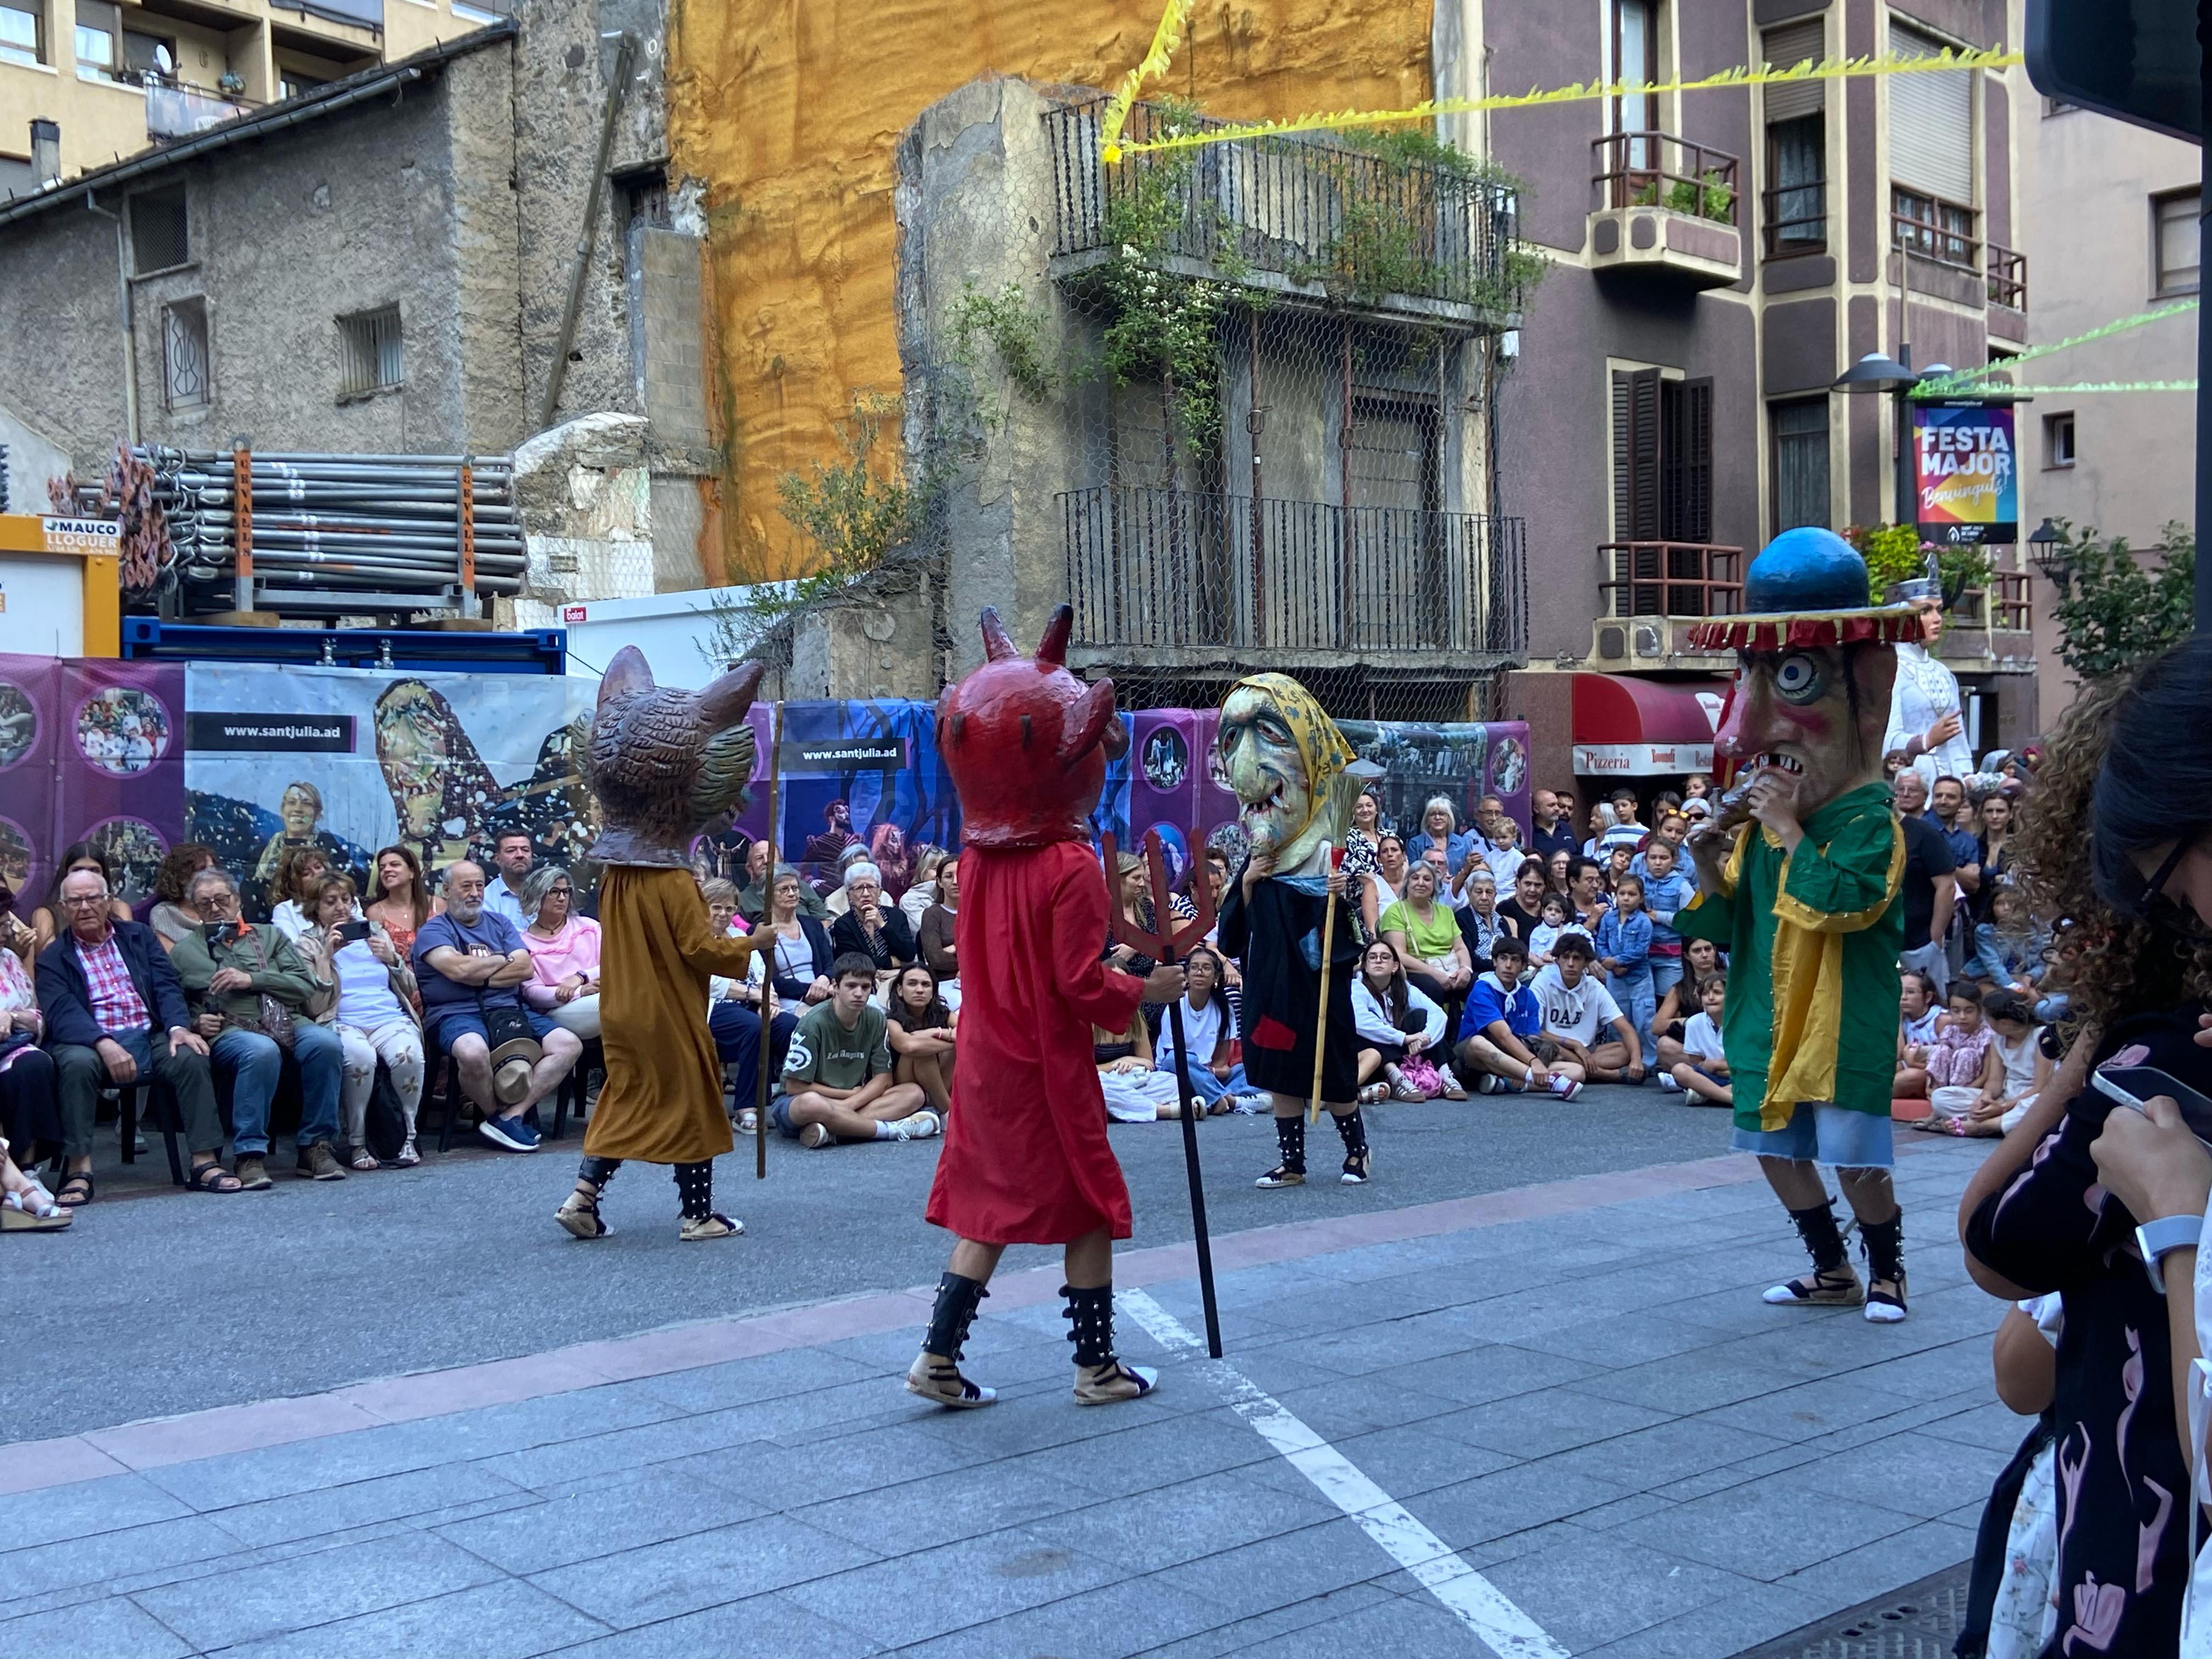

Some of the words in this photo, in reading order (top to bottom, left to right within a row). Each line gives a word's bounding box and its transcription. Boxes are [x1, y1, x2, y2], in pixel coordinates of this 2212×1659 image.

[1921, 426, 2009, 452] FESTA
[1921, 453, 2010, 475] MAJOR
[59, 522, 117, 535] MAUCO
[47, 533, 117, 548] LLOGUER
[224, 726, 341, 738] www.santjulia.ad
[803, 747, 897, 759] www.santjulia.ad
[1586, 752, 1629, 769] Pizzeria
